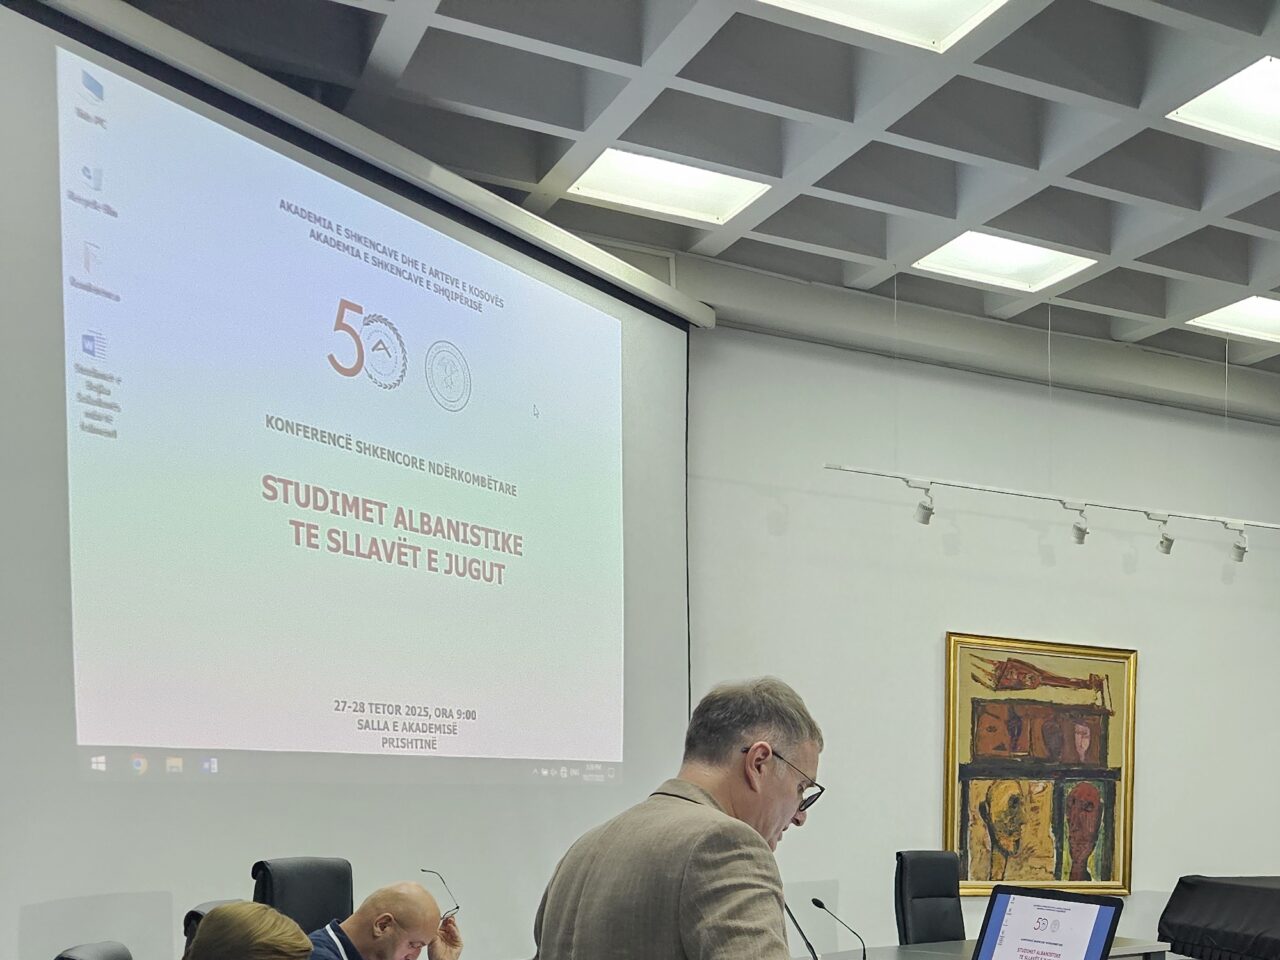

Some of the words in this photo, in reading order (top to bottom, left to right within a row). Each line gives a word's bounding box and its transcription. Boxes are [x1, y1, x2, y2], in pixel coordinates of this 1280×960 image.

[279, 199, 334, 232] AKADEMIA
[336, 224, 342, 236] E
[344, 228, 399, 262] SHKENCAVE
[401, 253, 420, 272] DHE
[421, 262, 427, 274] E
[428, 266, 460, 289] ARTEVE
[462, 280, 467, 292] E
[468, 284, 504, 309] KOSOVËS
[309, 228, 362, 260] AKADEMIA
[363, 251, 370, 264] E
[371, 255, 424, 288] SHKENCAVE
[425, 279, 432, 290] E
[433, 283, 483, 313] SHQIPËRISË
[265, 414, 353, 451] KONFERENCË
[355, 439, 426, 472] SHKENCORE
[428, 460, 518, 497] NDËRKOMBËTARE
[262, 474, 388, 526] STUDIMET
[394, 506, 523, 557] ALBANISTIKE
[289, 519, 320, 550] TE
[326, 528, 421, 569] SLLAVËT
[427, 549, 439, 573] E
[443, 552, 506, 585] JUGUT
[334, 700, 366, 714] 27-28
[368, 702, 402, 716] TETOR
[405, 705, 432, 719] 2025,
[434, 707, 454, 720] ORA
[456, 709, 477, 721] 9:00
[357, 719, 390, 732] SALLA
[393, 721, 399, 733] E
[401, 722, 458, 736] AKADEMISË
[381, 737, 438, 751] PRISHTINË
